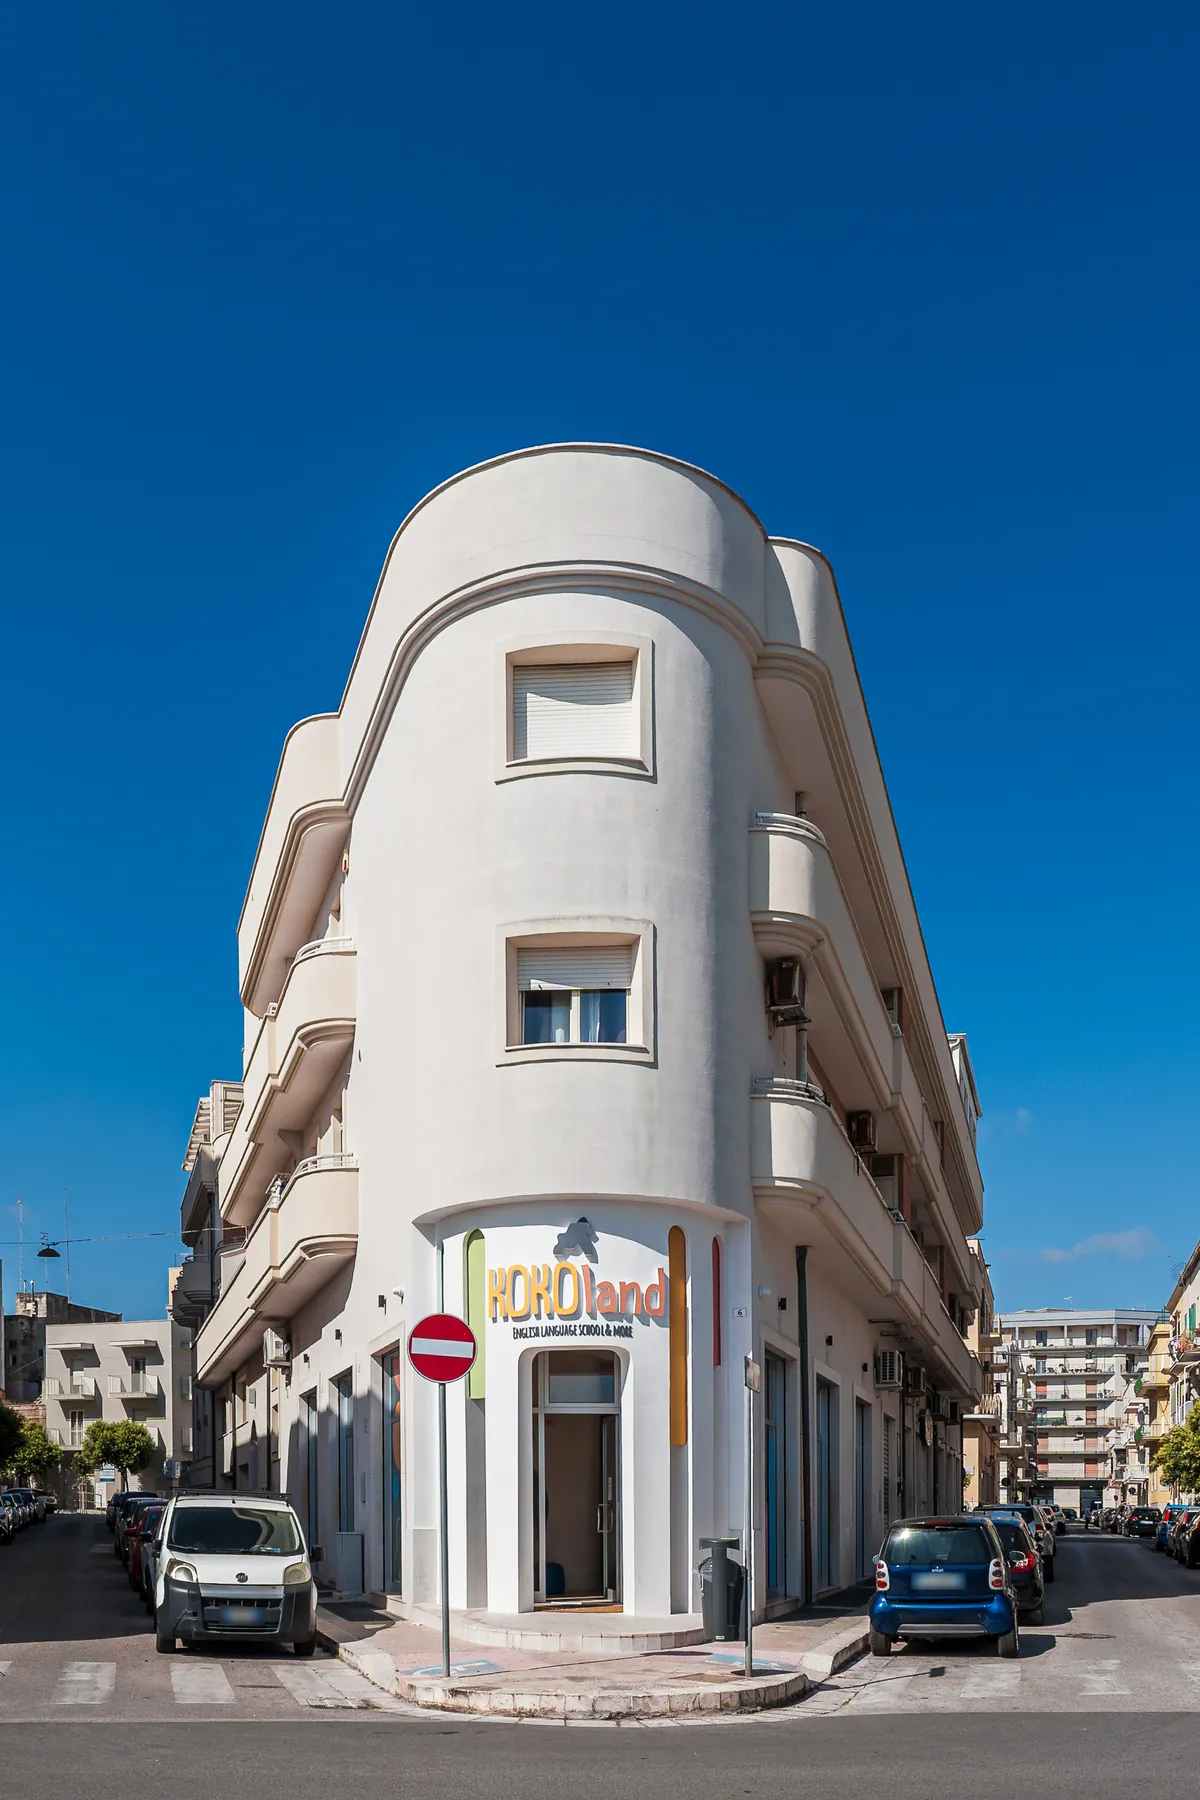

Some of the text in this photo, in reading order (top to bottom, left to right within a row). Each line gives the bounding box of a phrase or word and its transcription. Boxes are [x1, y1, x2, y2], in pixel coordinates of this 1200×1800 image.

[488, 1261, 664, 1318] KOKOland
[737, 1308, 743, 1316] 6
[513, 1323, 634, 1339] ENGLISH LANGUAGE SCHOOL & MORE
